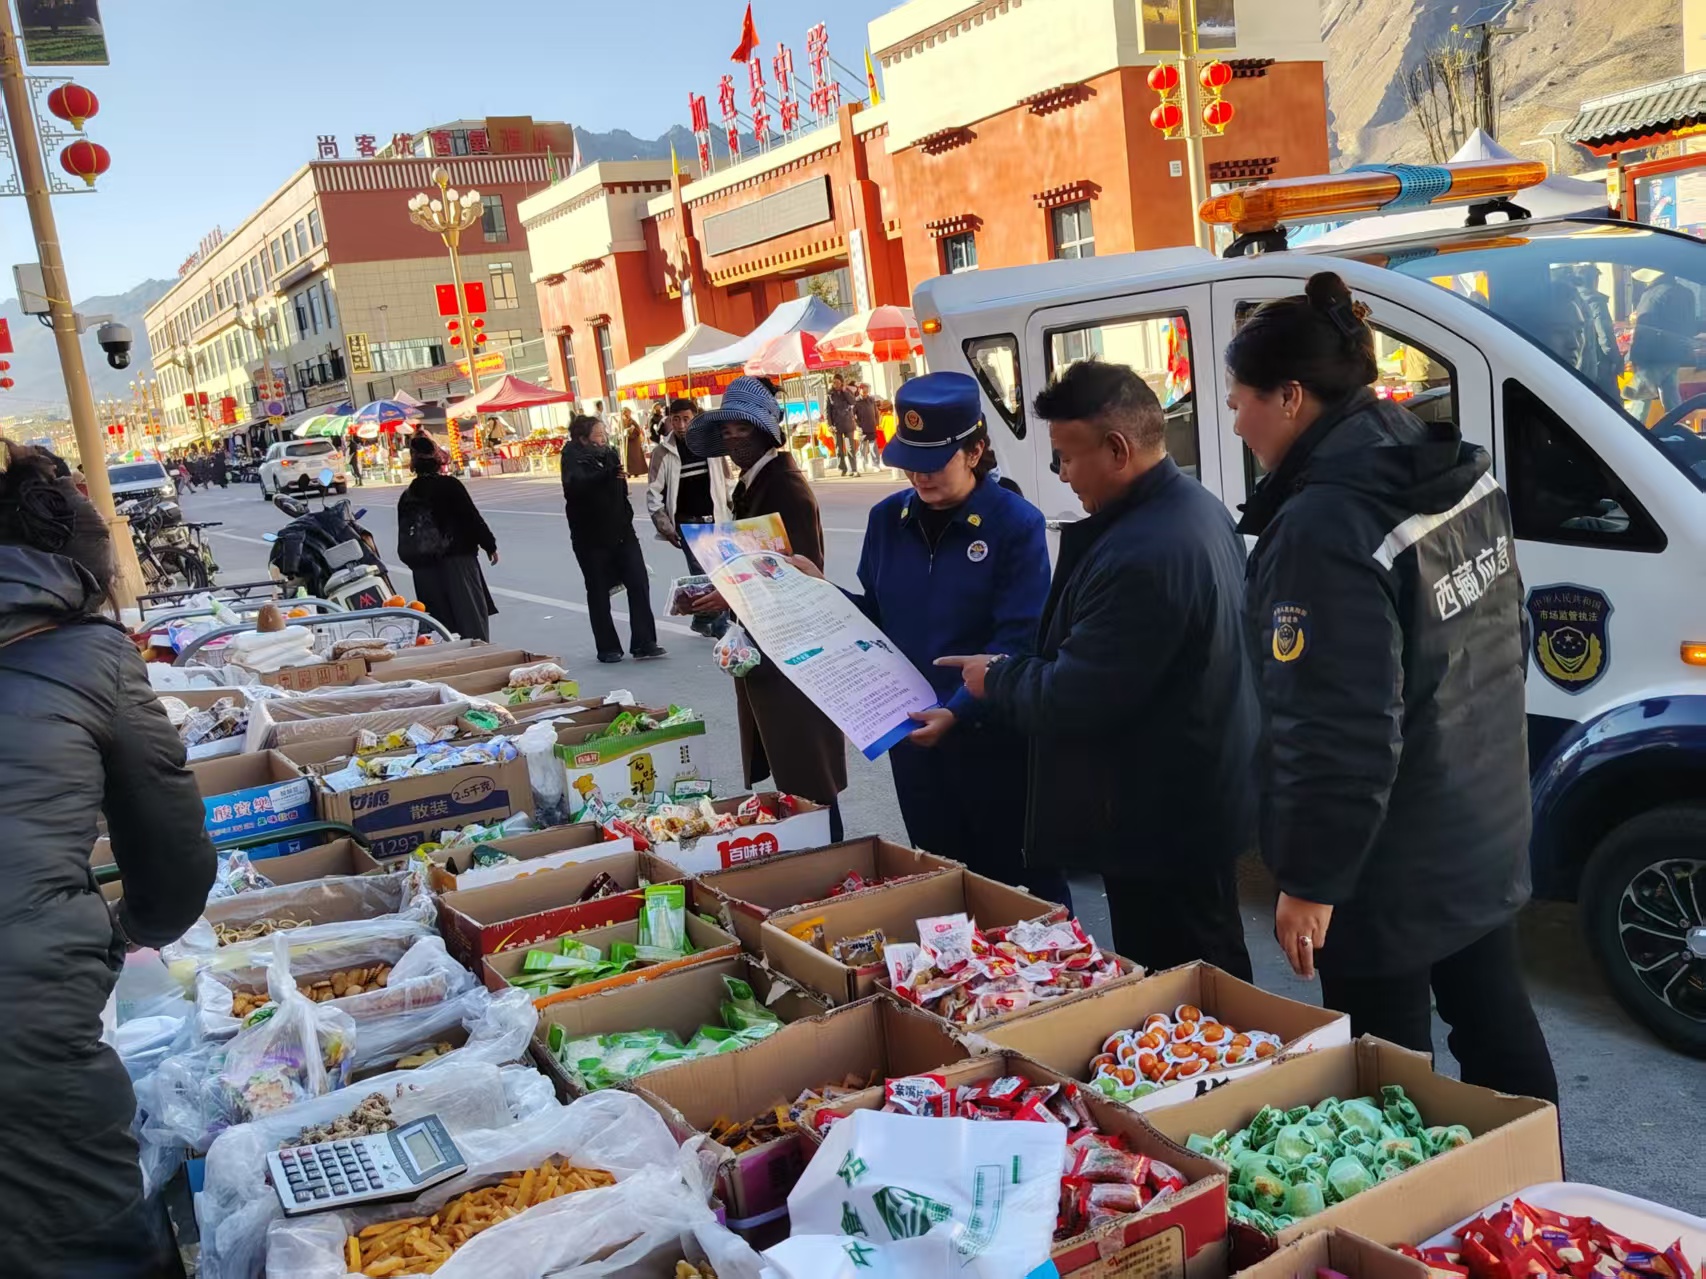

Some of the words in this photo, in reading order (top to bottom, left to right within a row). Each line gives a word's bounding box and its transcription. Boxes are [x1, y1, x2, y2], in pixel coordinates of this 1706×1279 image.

[1433, 536, 1511, 621] 西藏应急
[1540, 609, 1599, 622] 市场监管执法
[453, 780, 493, 801] 2.5千克
[409, 799, 450, 821] 散装
[729, 840, 773, 863] 百味祥
